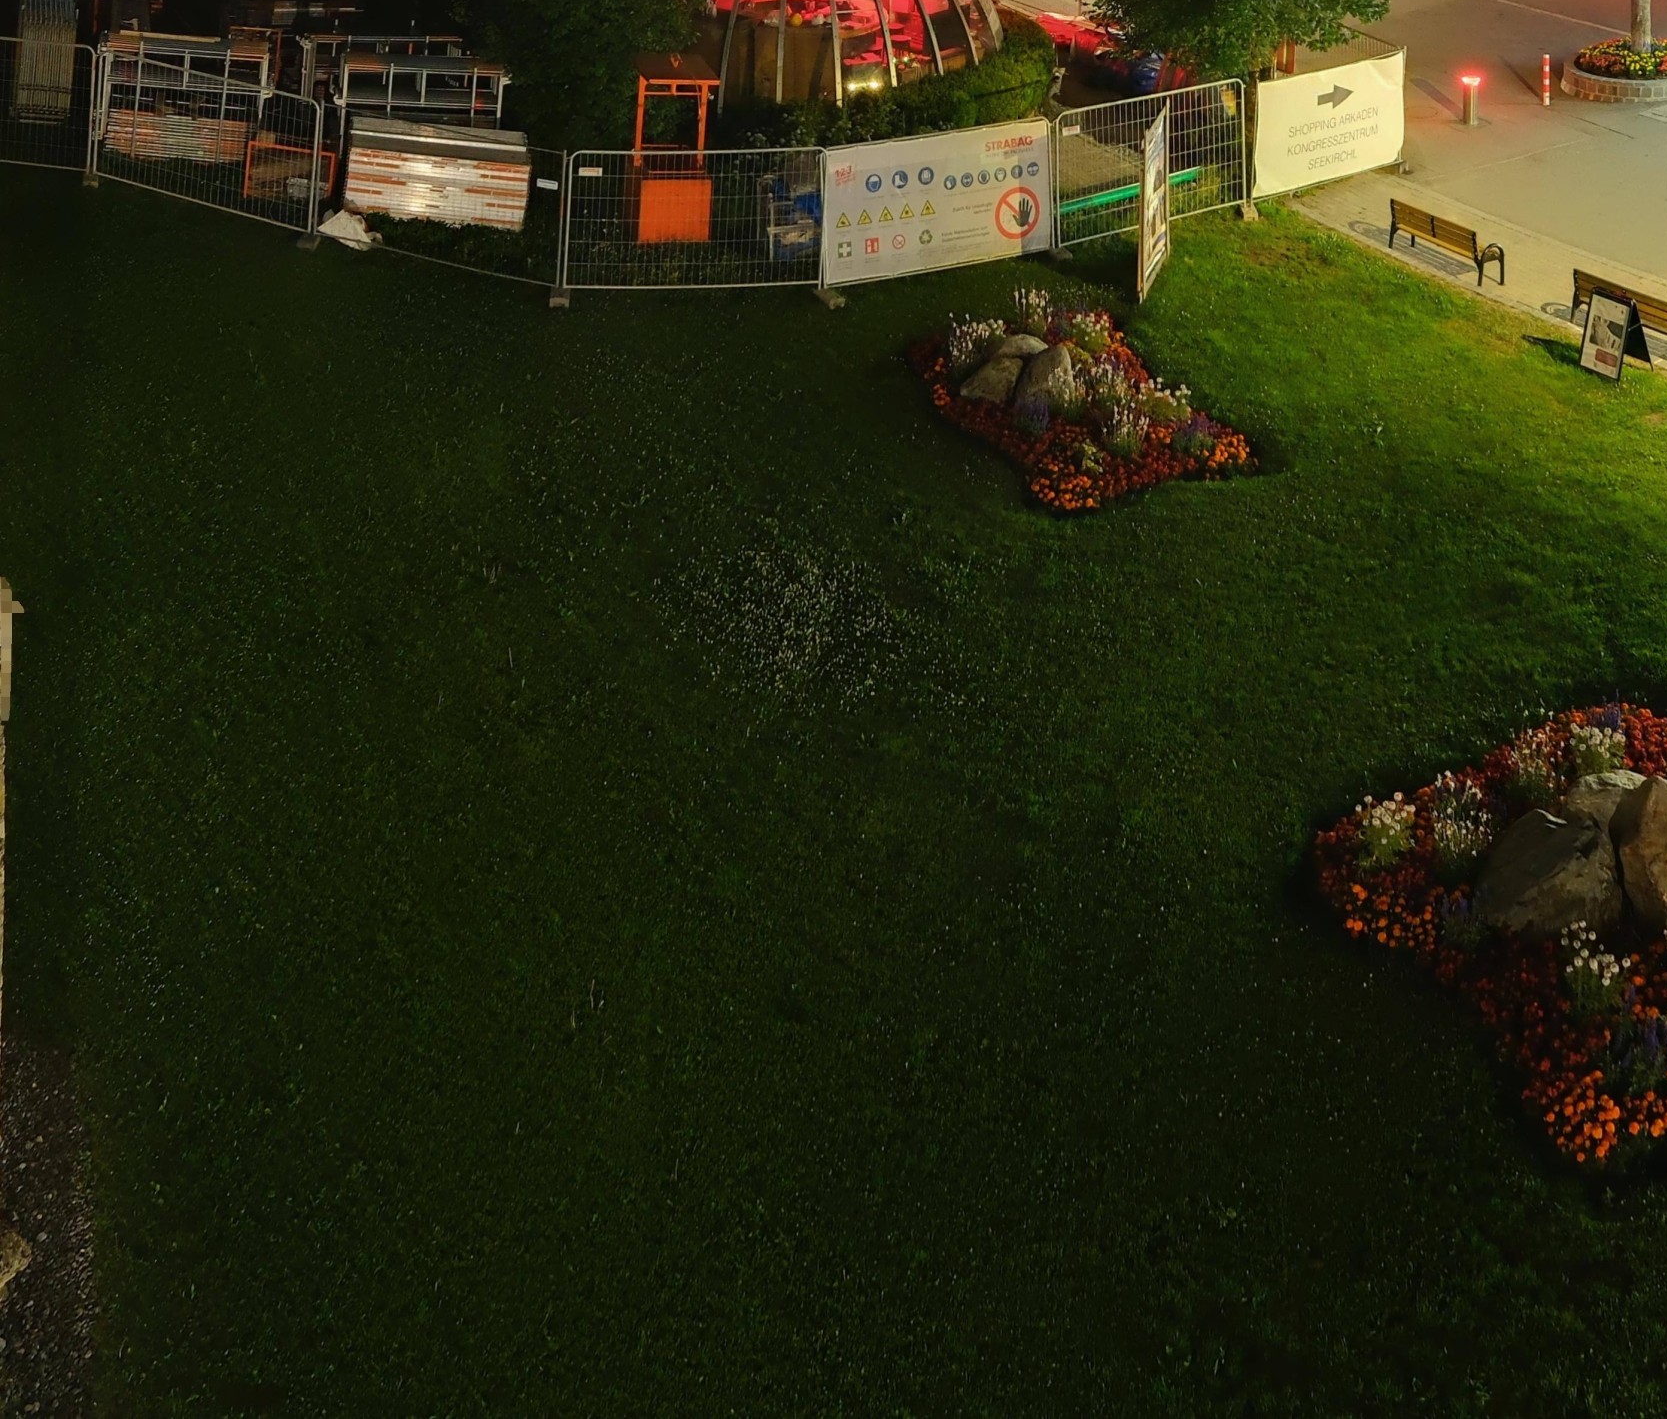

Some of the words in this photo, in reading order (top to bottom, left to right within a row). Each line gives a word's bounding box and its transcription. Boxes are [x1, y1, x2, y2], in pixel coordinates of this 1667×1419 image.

[1288, 116, 1337, 139] SHOPPING
[1339, 106, 1379, 126] ARKADEN
[985, 135, 1033, 152] STRABAG
[1287, 124, 1379, 157] KONGRESSZENTRUM
